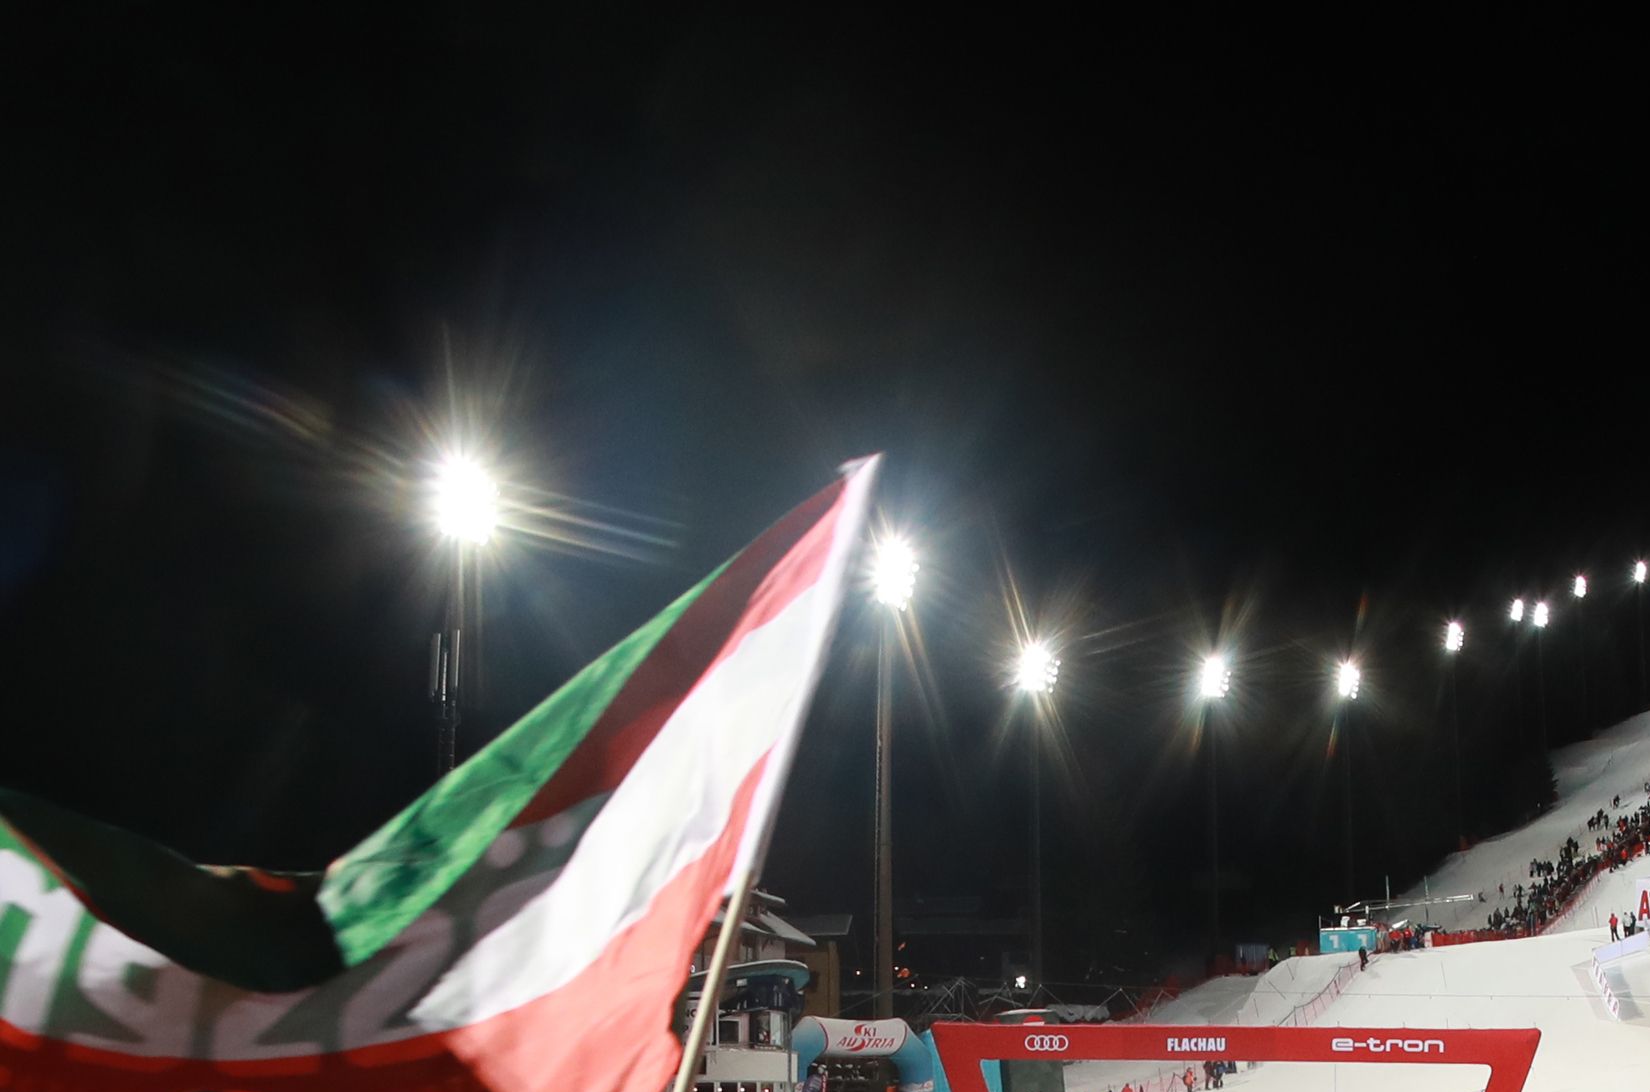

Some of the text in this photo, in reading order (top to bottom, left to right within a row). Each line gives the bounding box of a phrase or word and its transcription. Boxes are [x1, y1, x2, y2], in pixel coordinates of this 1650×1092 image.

[854, 1023, 877, 1038] SKI
[836, 1037, 896, 1052] AUSTRIA
[1167, 1037, 1226, 1052] FLACHAU
[1332, 1038, 1445, 1053] e-tron
